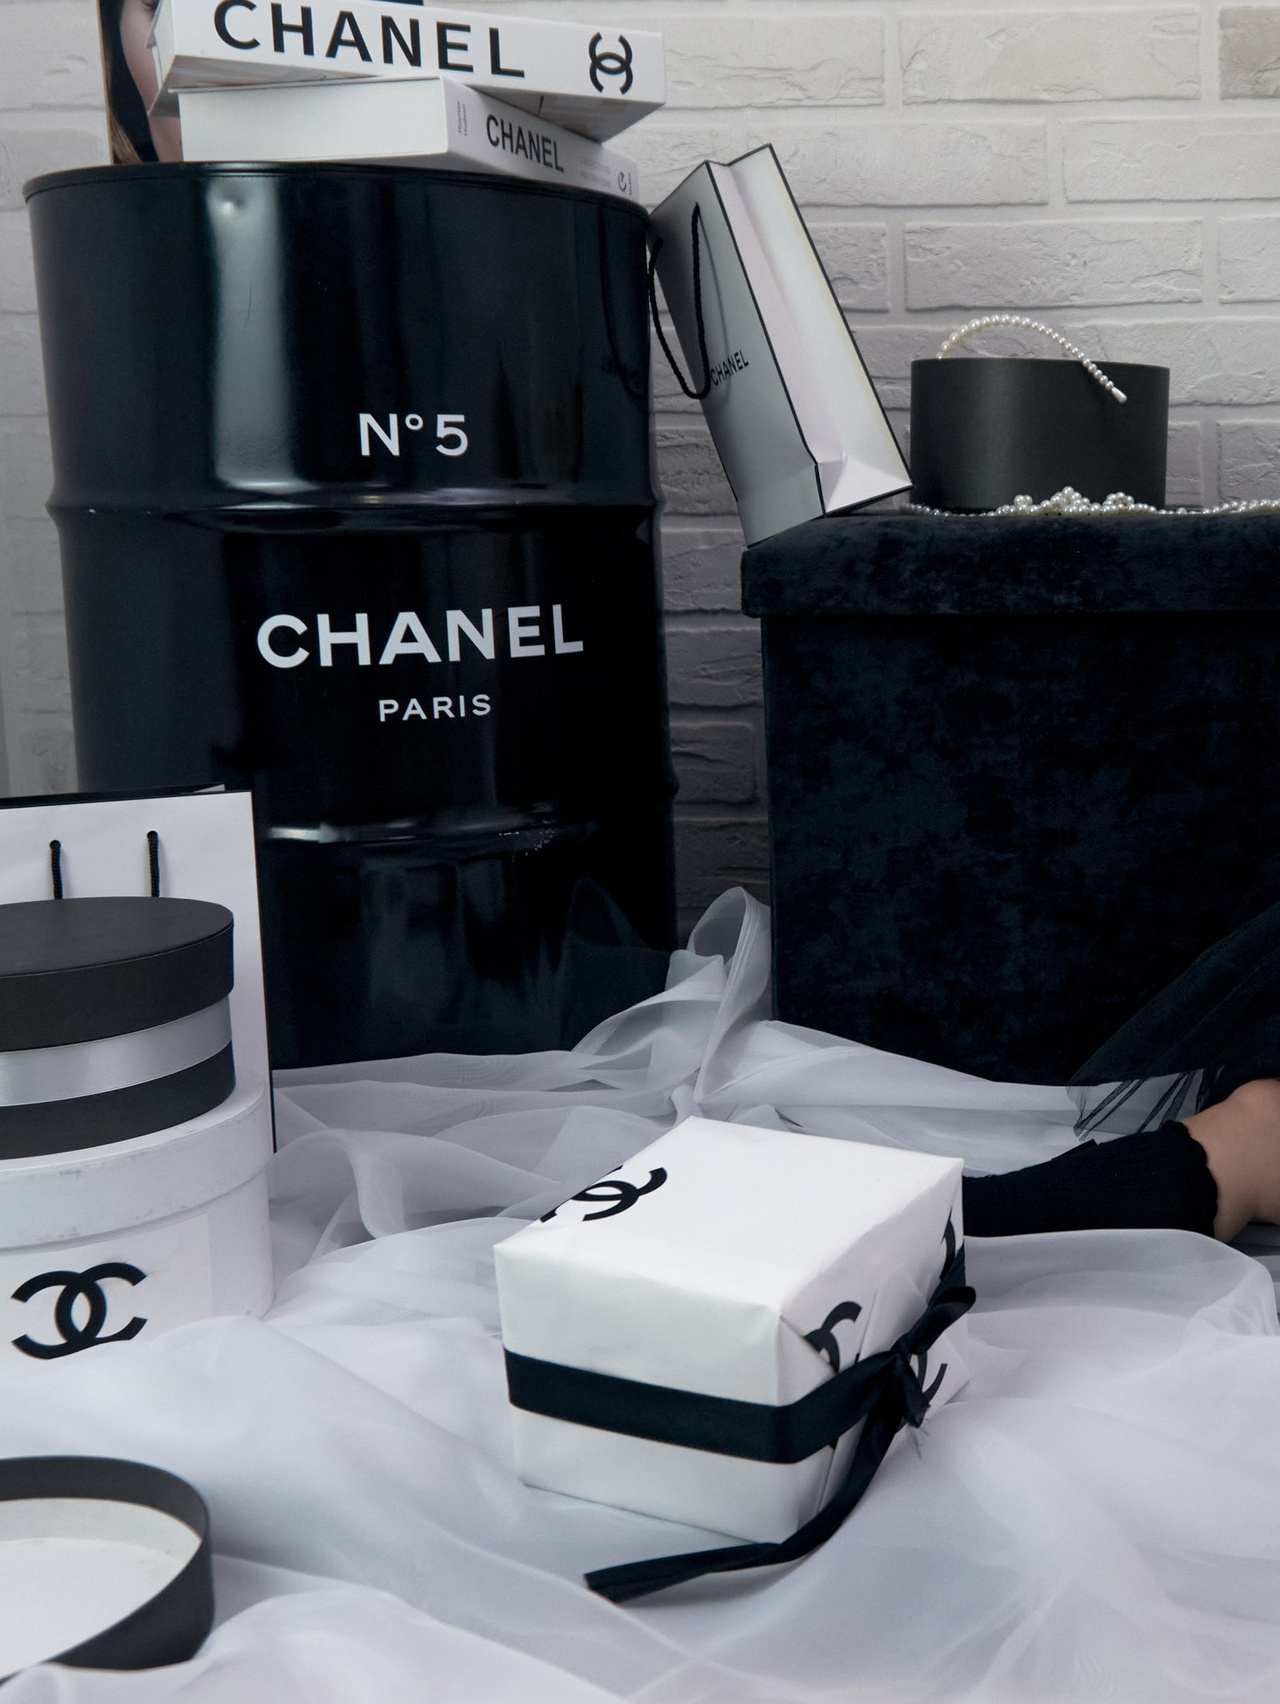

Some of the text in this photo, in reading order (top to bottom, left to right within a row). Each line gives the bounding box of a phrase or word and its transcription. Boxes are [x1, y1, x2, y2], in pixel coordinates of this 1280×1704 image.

[213, 0, 525, 78] CHANEL
[486, 113, 564, 173] CHANEL
[710, 349, 749, 386] CHANEL
[256, 603, 584, 669] CHANEL
[378, 694, 491, 722] PARIS
